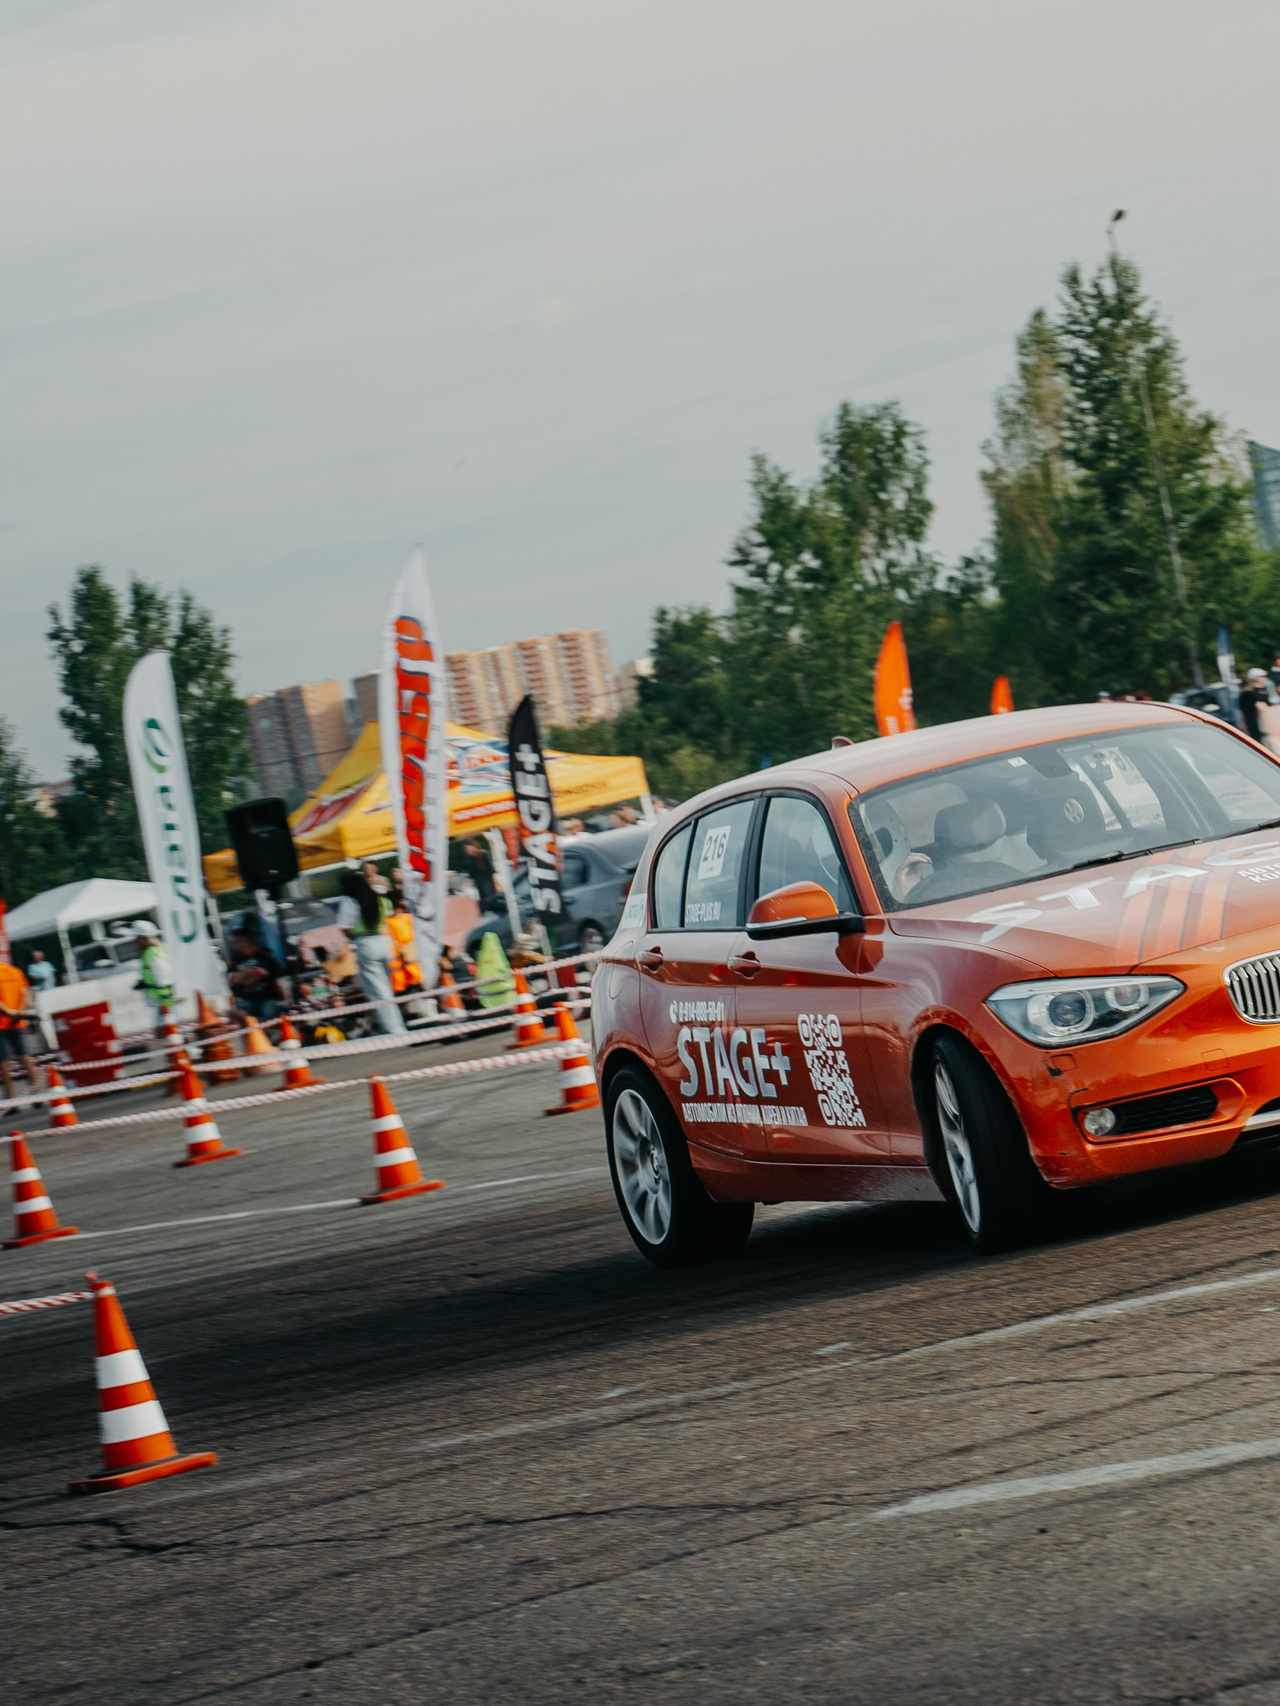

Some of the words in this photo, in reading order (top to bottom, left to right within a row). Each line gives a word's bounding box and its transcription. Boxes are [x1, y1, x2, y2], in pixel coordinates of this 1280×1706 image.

[514, 743, 562, 914] STAGE+
[702, 832, 727, 862] 216
[676, 1025, 792, 1098] STAGE+
